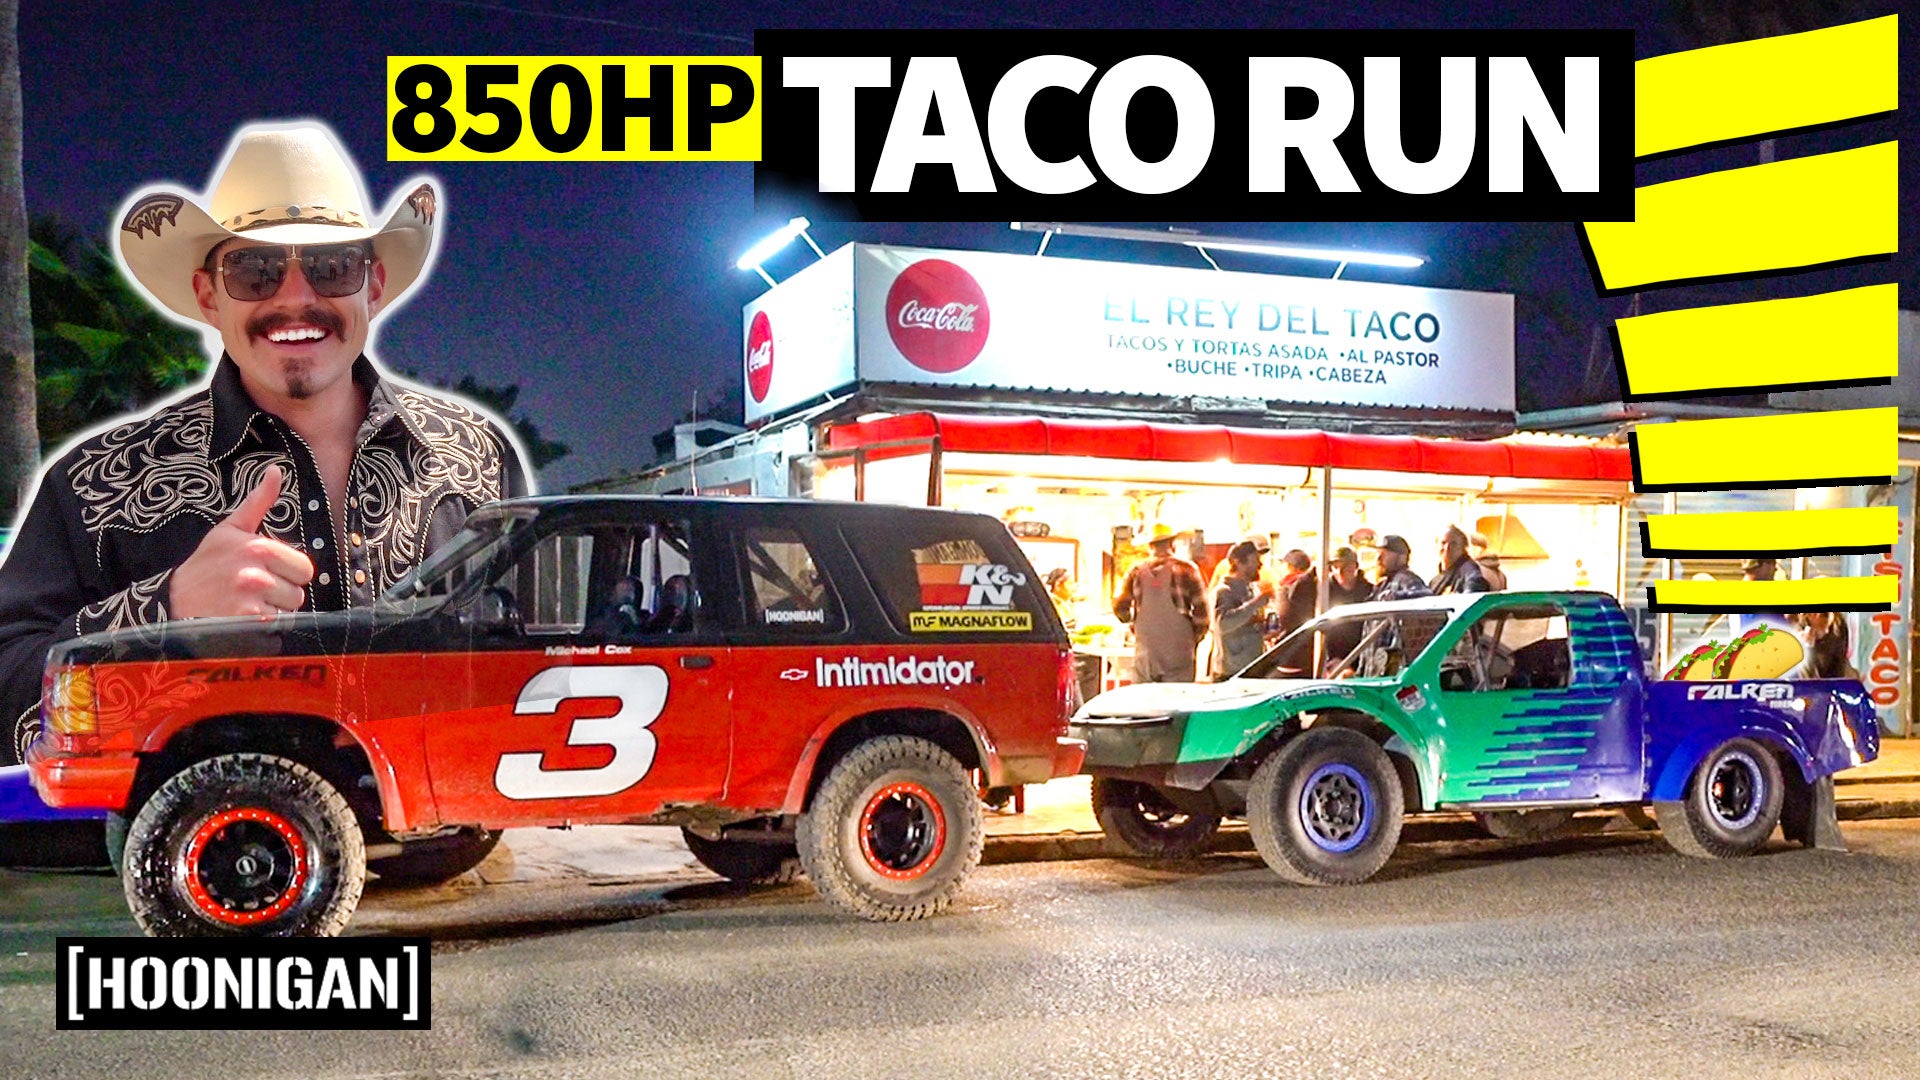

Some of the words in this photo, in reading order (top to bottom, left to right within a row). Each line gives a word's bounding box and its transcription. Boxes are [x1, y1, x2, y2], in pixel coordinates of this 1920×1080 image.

[898, 299, 979, 333] Coca-Cola
[1104, 296, 1150, 324] EL
[1166, 296, 1241, 330] REY
[1258, 303, 1330, 336] DEL
[1343, 308, 1441, 344] TACO
[1107, 333, 1168, 352] TACOS
[1174, 338, 1184, 352] Y
[1191, 338, 1262, 358] TORTAS
[1267, 344, 1329, 362] ASADA
[1374, 350, 1440, 369] PASTOR
[940, 615, 1028, 628] MAGNAFLOW
[545, 645, 600, 656] Michael
[604, 644, 633, 655] Cox
[1870, 612, 1902, 706] TACO
[186, 664, 327, 684] FALKEN
[815, 655, 975, 687] Intimidator
[1687, 682, 1795, 701] FALKEN
[494, 664, 670, 801] 3
